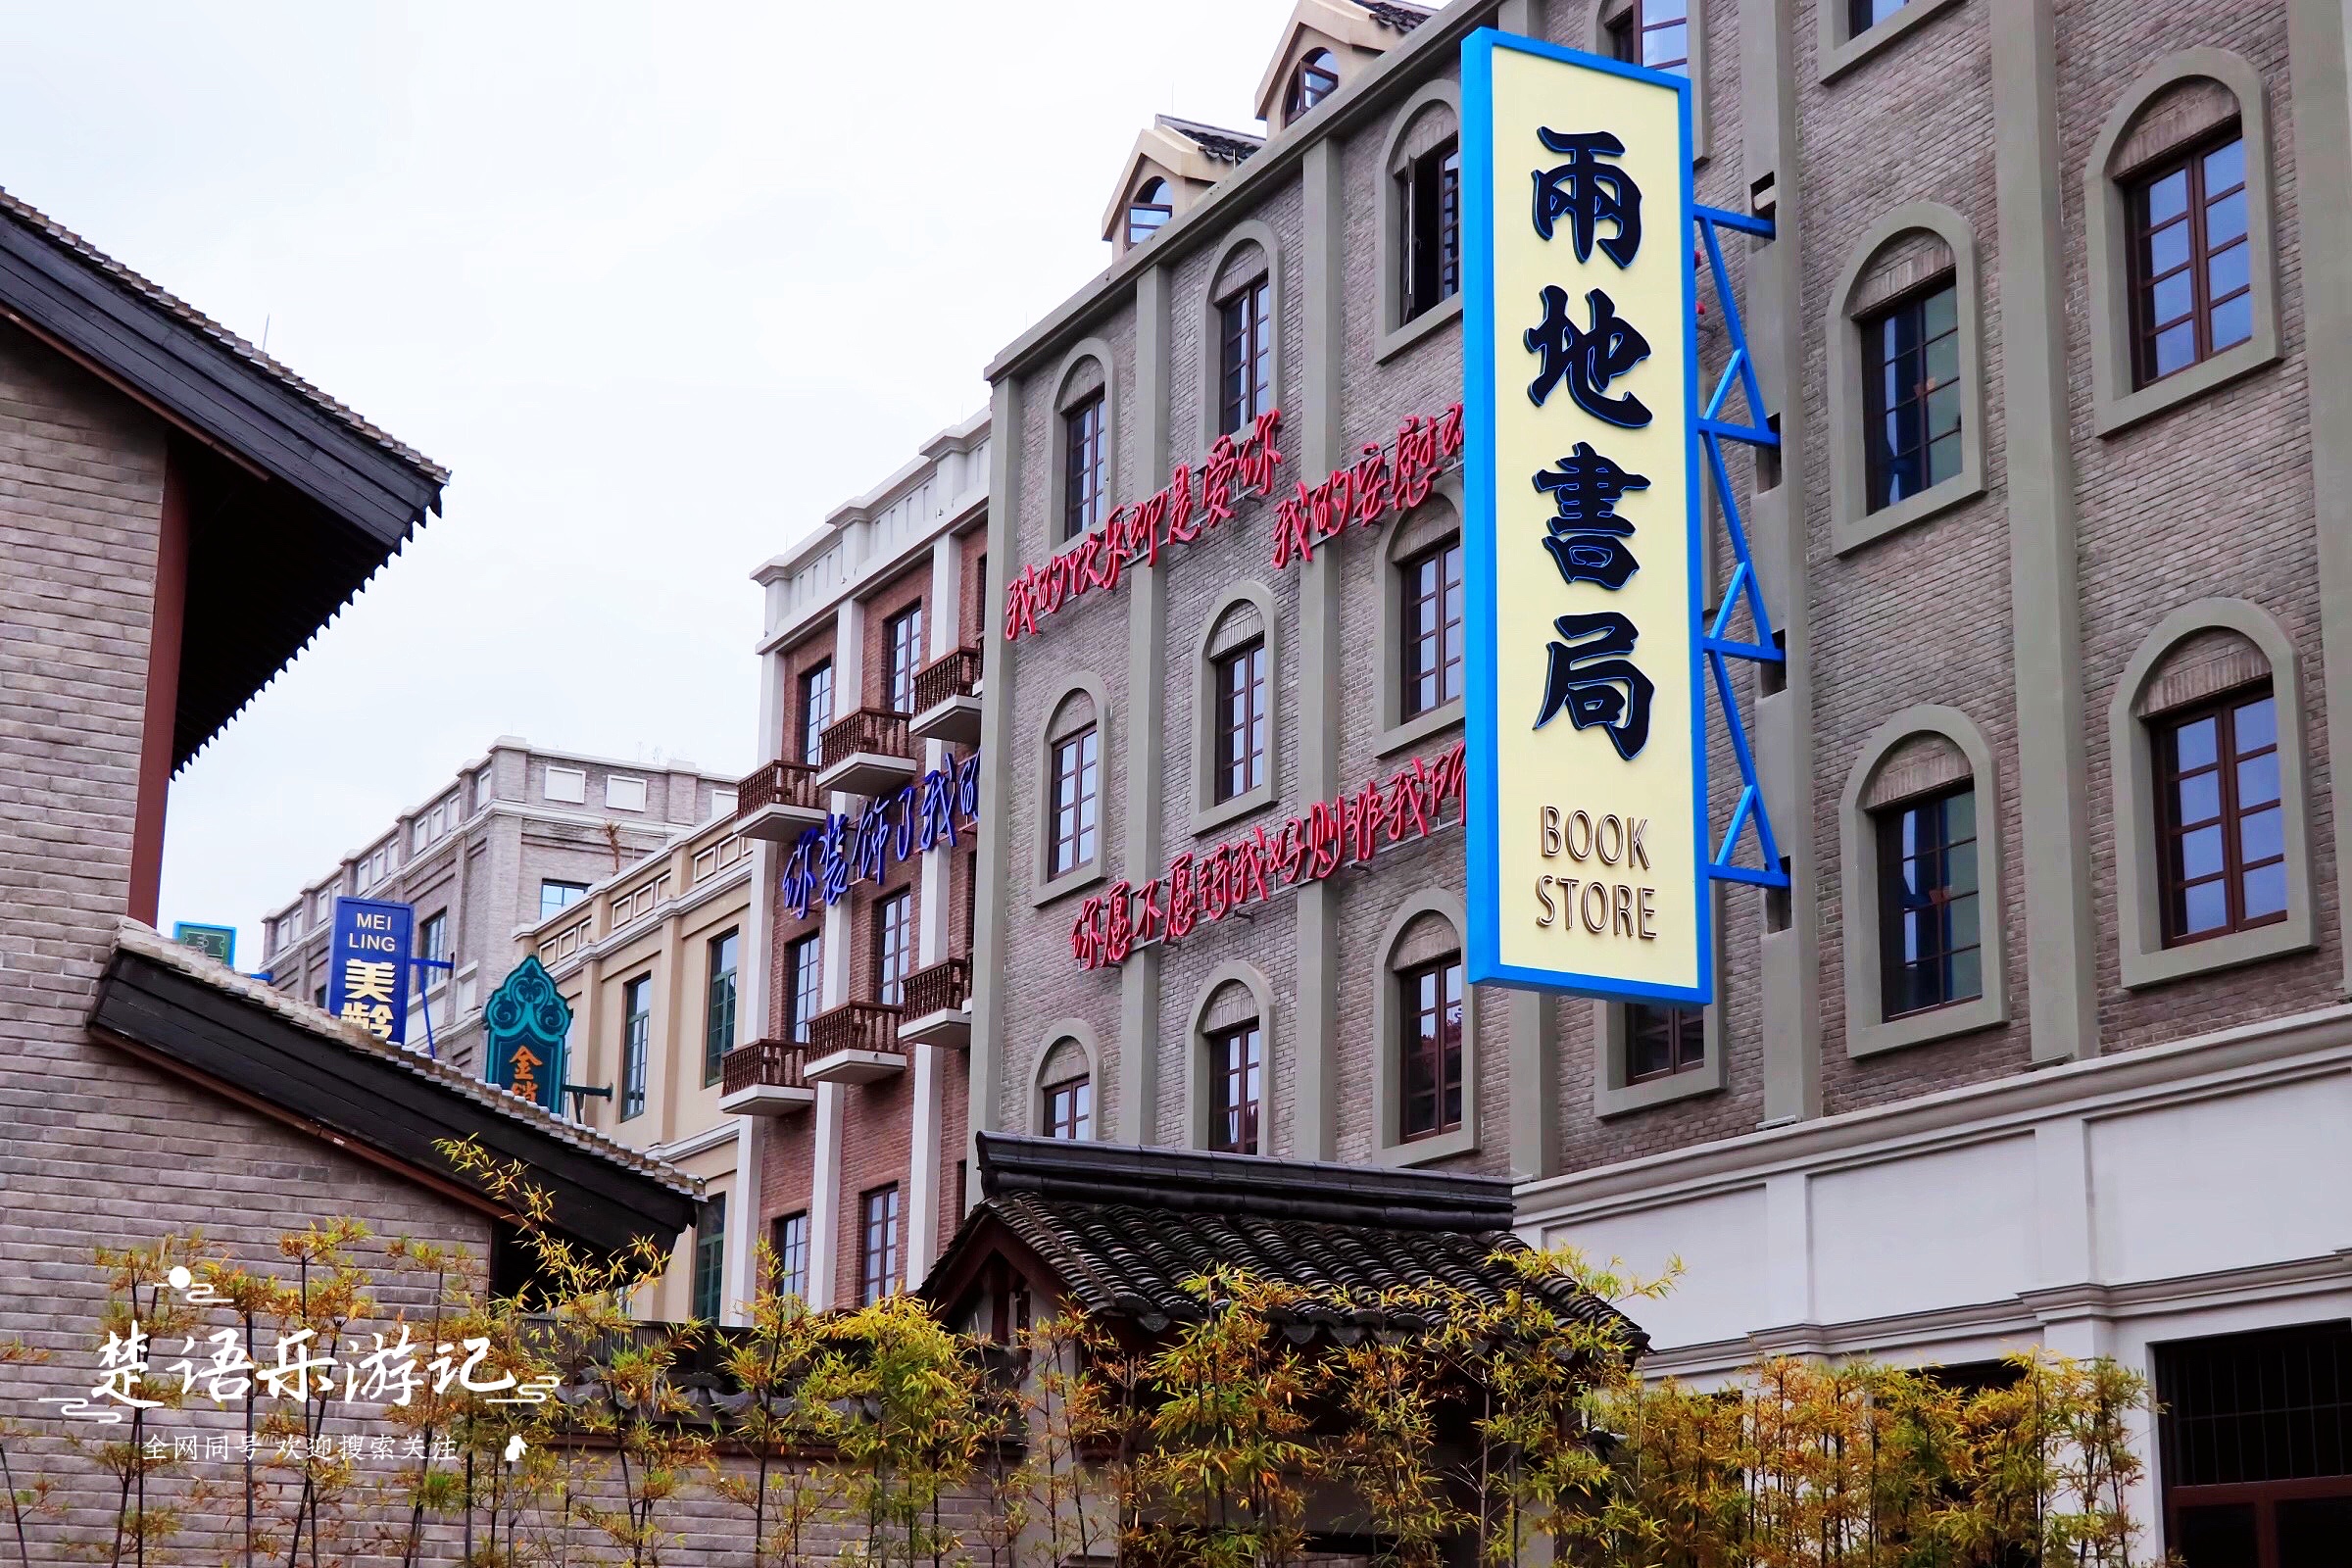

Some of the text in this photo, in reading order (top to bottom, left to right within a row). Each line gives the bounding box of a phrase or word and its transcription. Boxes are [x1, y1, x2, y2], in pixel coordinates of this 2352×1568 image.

[1541, 805, 1651, 870] BOOK
[356, 912, 392, 930] MEI
[1535, 874, 1657, 940] STORE
[348, 932, 396, 953] LING
